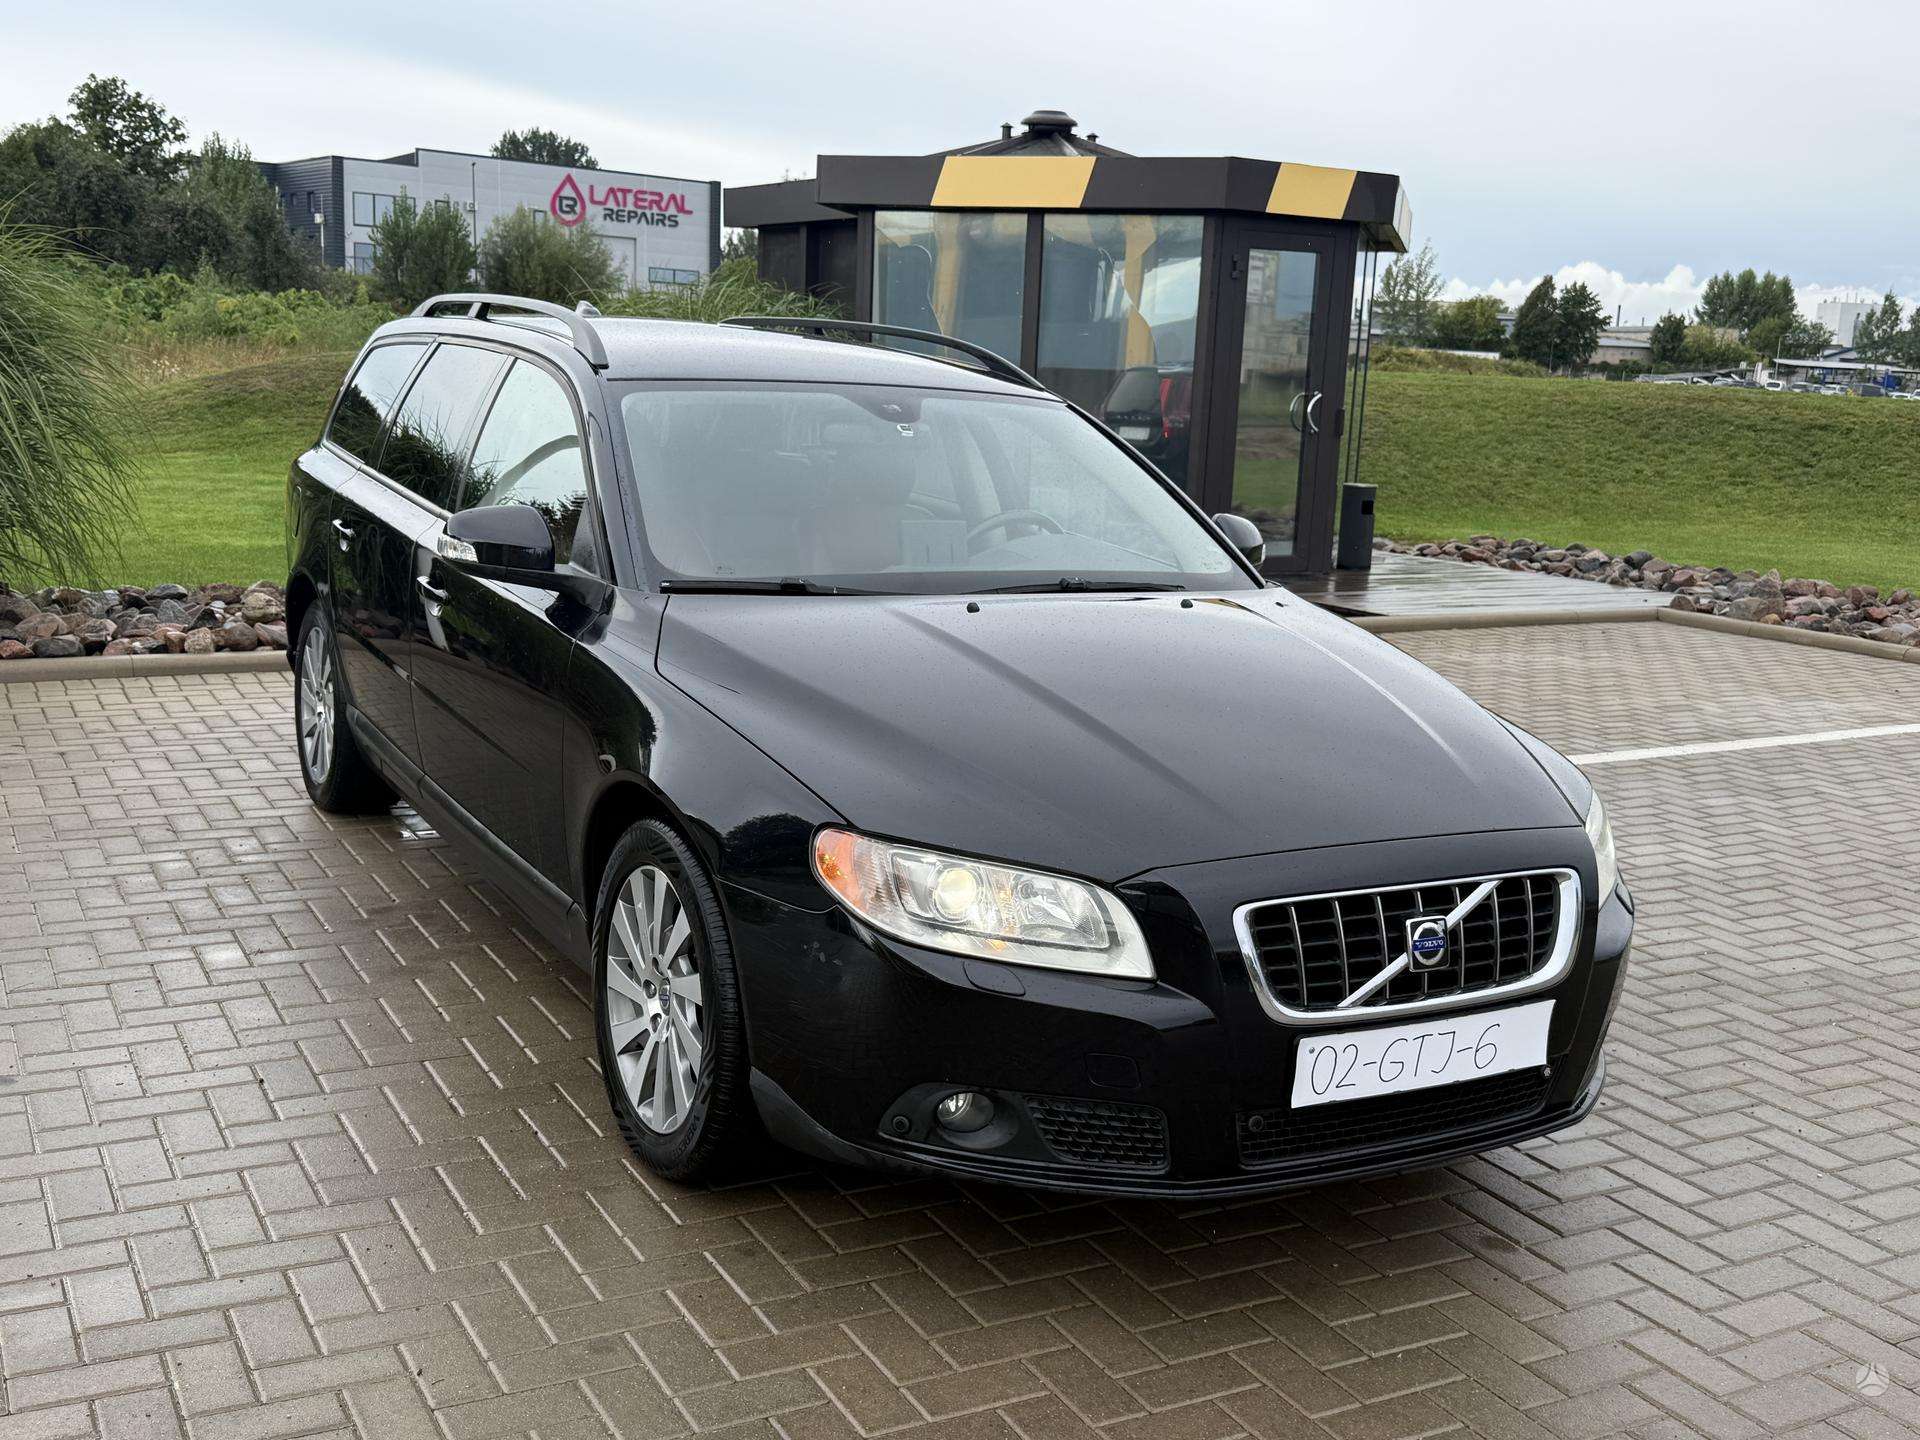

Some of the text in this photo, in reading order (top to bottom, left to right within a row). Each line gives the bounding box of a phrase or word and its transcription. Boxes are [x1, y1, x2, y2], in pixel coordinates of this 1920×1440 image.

[589, 185, 693, 215] LATERAL
[603, 208, 679, 228] REPAIRS
[1415, 940, 1444, 949] VOLVO
[1311, 1024, 1500, 1095] 02-GTJ-6
